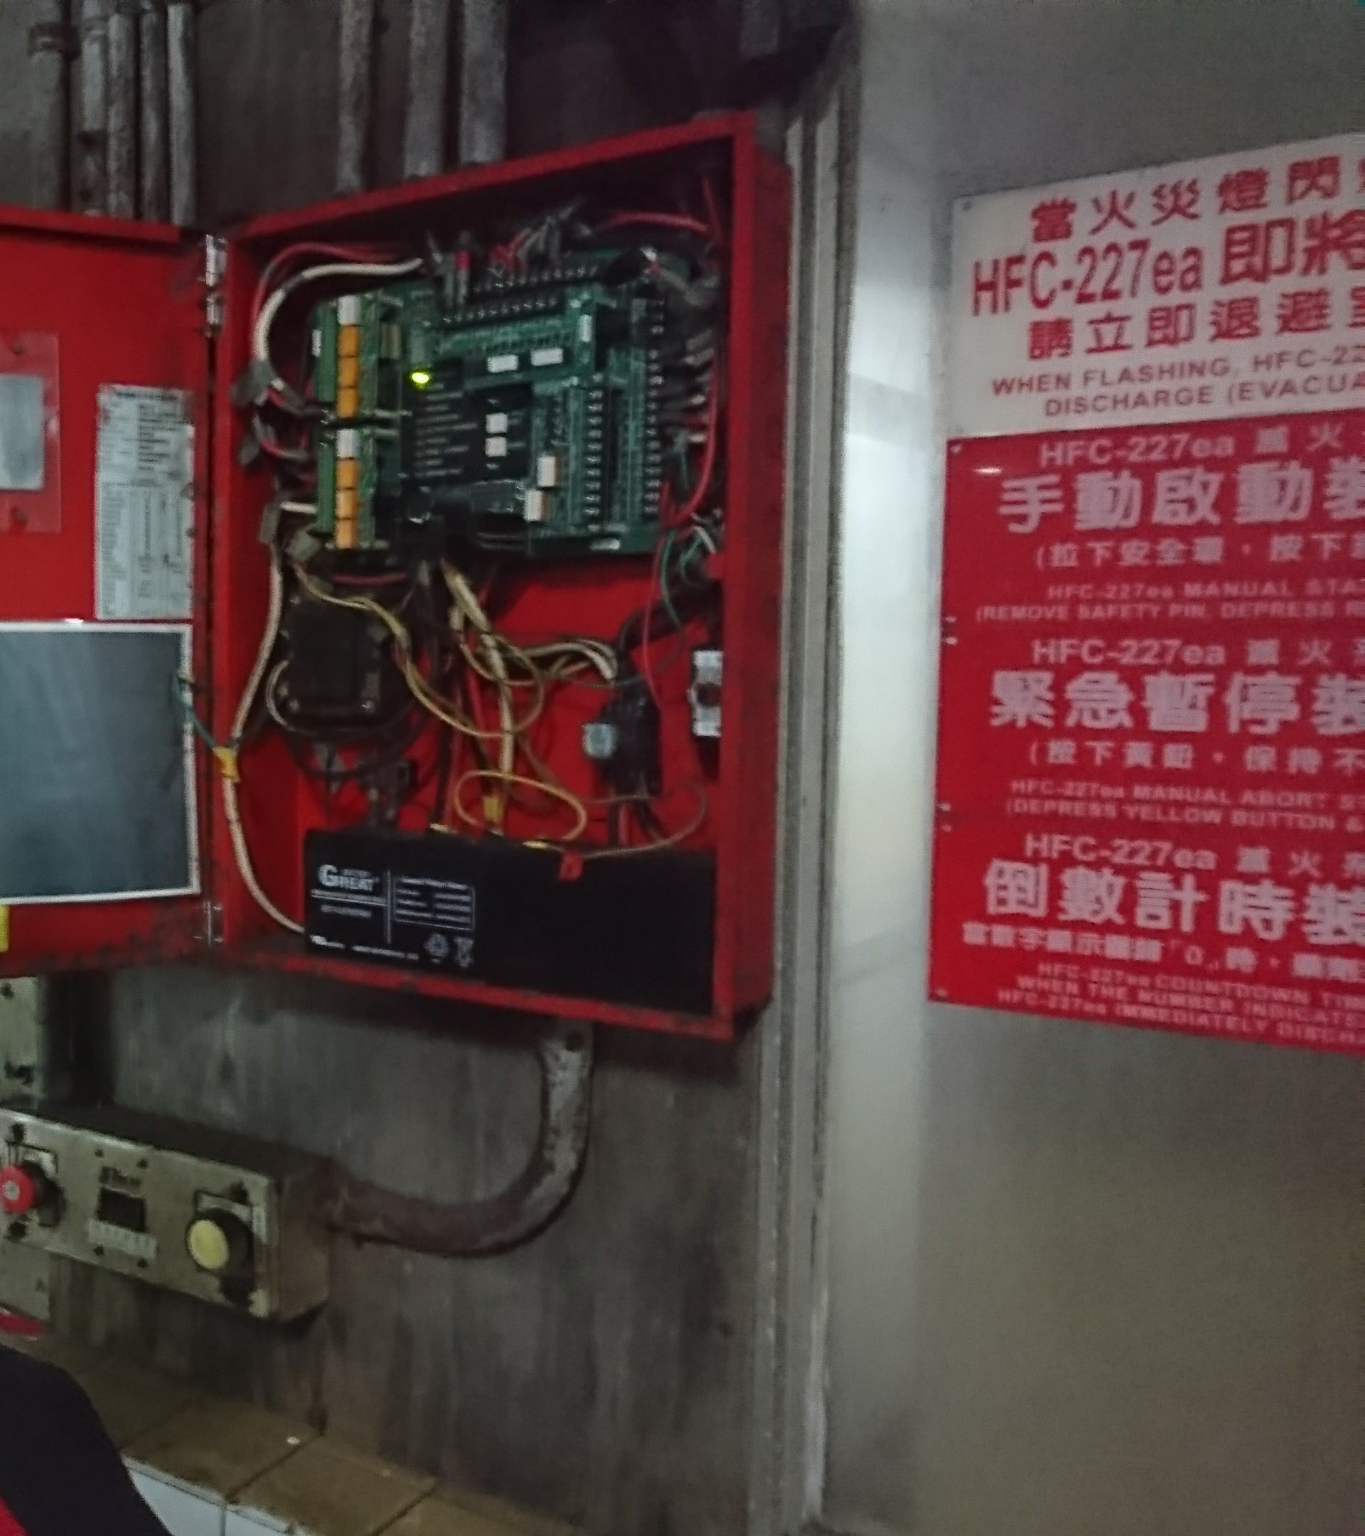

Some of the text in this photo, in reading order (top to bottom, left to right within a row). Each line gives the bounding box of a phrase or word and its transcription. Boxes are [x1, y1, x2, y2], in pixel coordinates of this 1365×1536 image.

[1031, 155, 1365, 243] 當火災燈閃
[973, 238, 1203, 316] HFC-227ea
[992, 372, 1072, 397] WHEN
[1044, 385, 1213, 417] DISCHARGE
[1040, 434, 1234, 467] HFC-227ea
[1184, 579, 1294, 598] MANUAL
[1078, 603, 1162, 620] SAFETY
[1220, 601, 1334, 619] DEPRESS
[1032, 637, 1226, 666] HFC-227ea
[1133, 784, 1231, 804] MANUAL
[1122, 803, 1223, 825] YELLOW
[1231, 810, 1336, 831] BUTTON
[1025, 833, 1218, 872] HFC-227ea
[1088, 982, 1128, 999] THE
